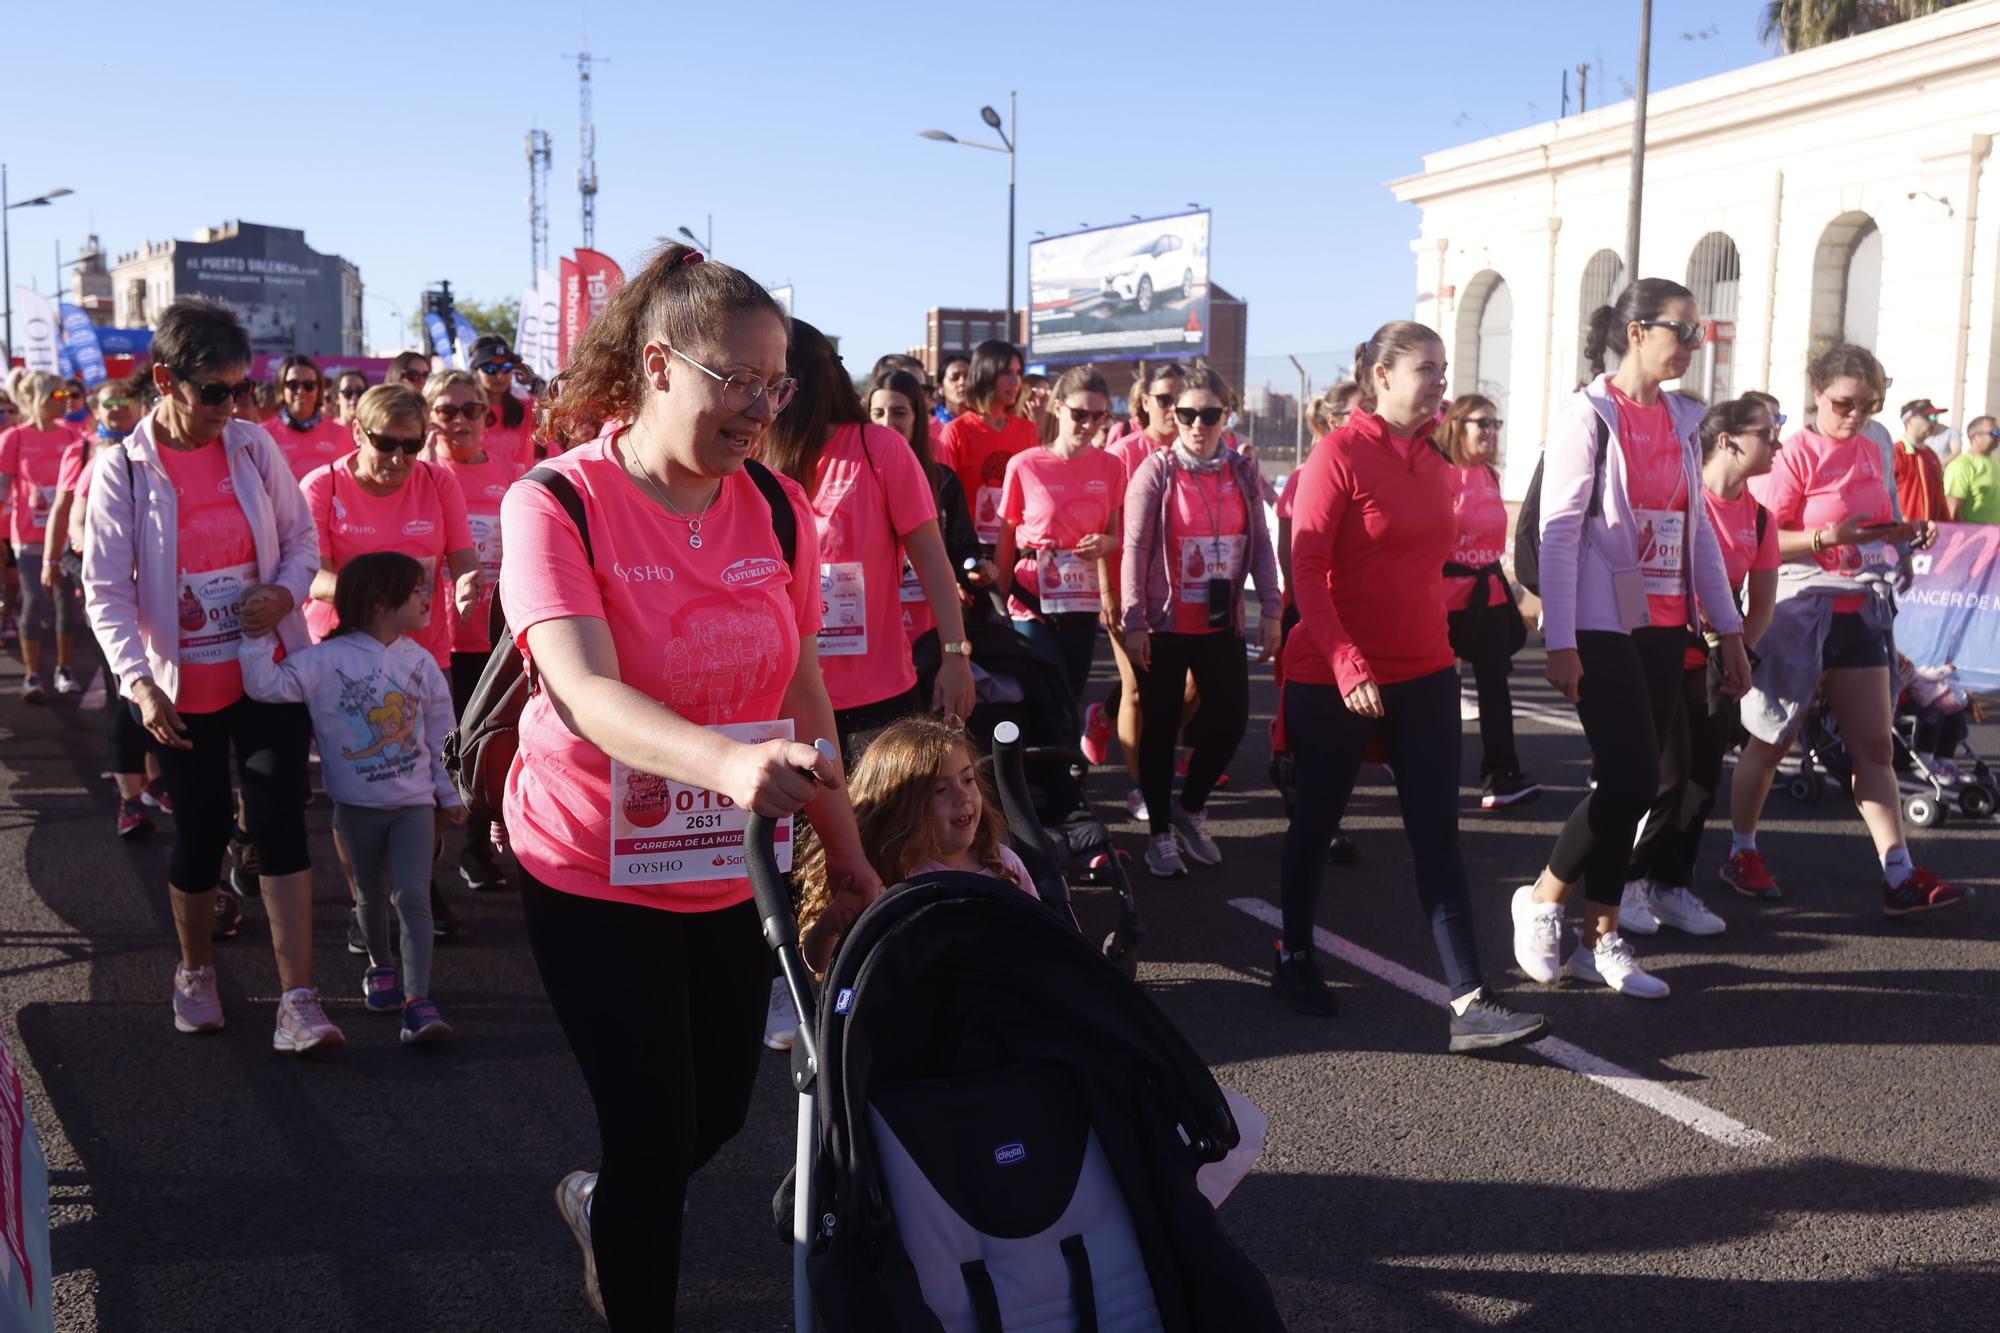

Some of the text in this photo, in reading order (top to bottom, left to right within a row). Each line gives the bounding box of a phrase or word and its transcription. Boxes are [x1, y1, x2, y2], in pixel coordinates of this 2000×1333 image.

[727, 565, 777, 583] ASTURIANA
[1965, 592, 1990, 610] DE
[675, 788, 735, 812] 016
[686, 814, 722, 830] 2631
[634, 834, 744, 851] CARRERA DE LA MUJE
[628, 859, 683, 875] OYSHO
